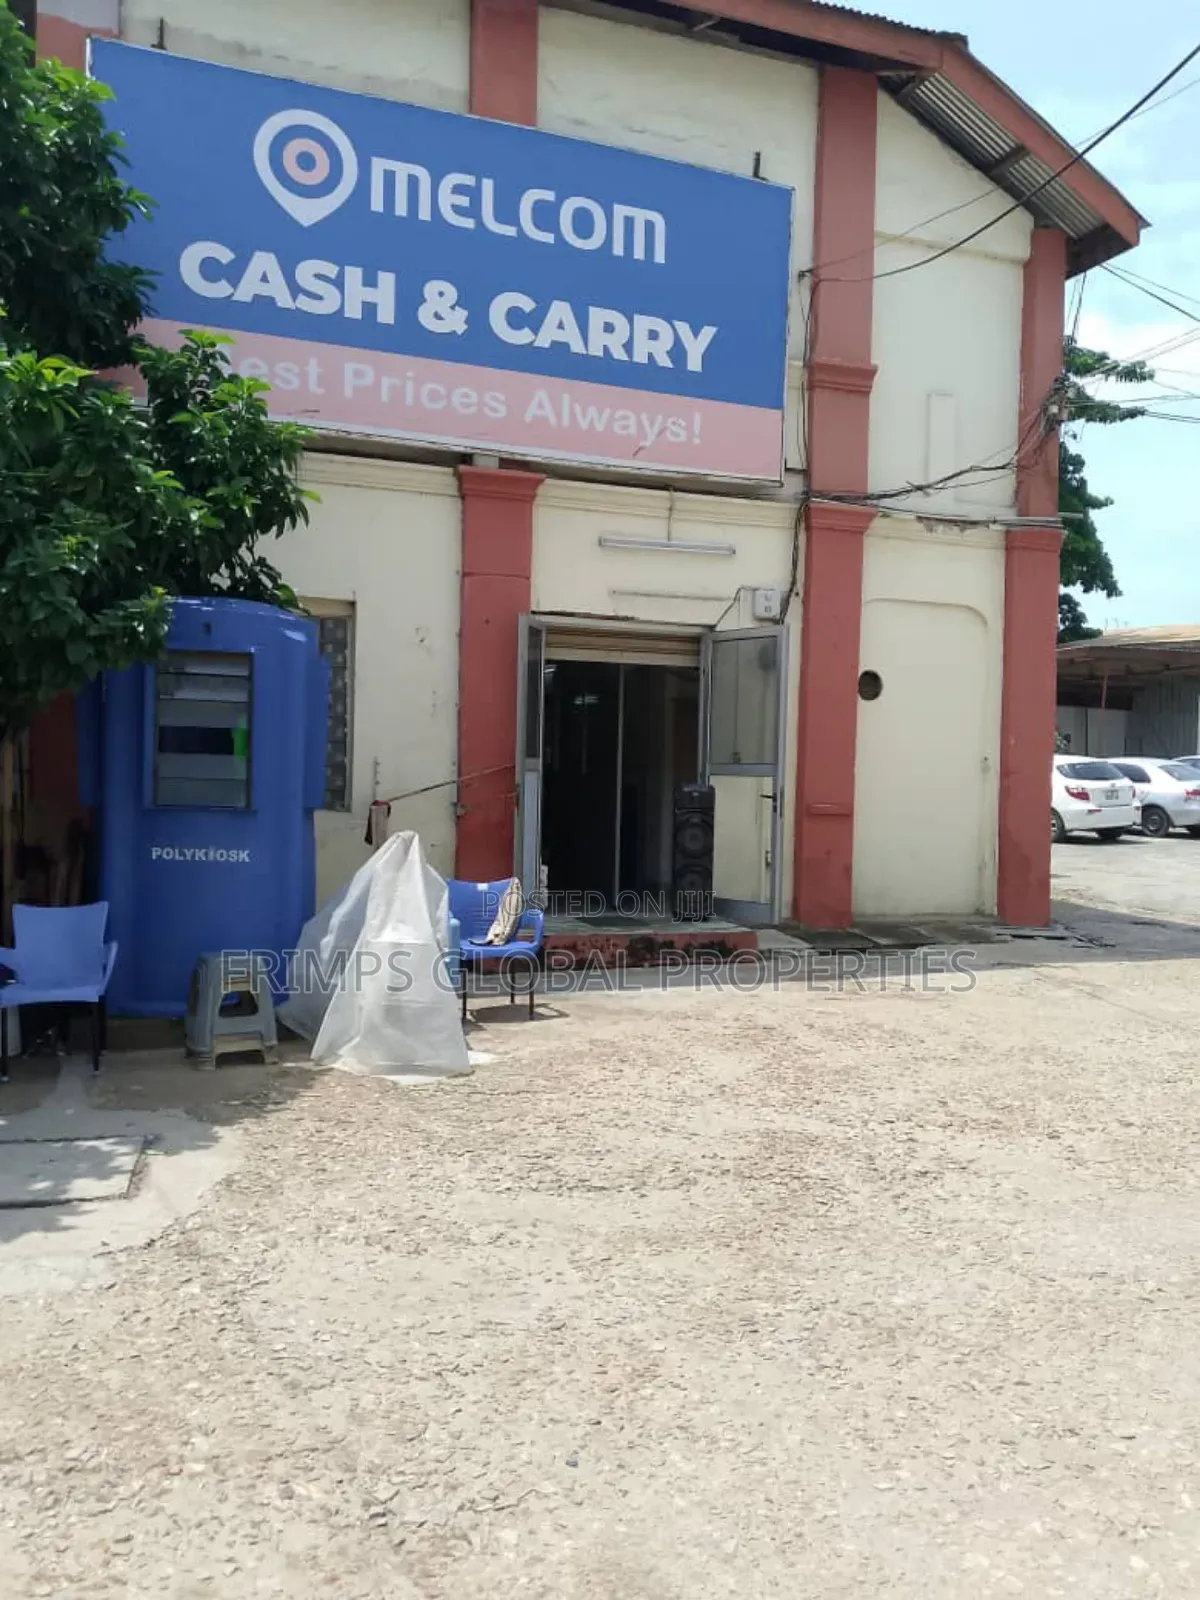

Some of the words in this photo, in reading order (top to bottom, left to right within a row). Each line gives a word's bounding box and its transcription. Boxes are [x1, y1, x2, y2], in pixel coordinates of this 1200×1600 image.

[370, 156, 667, 265] MELCOM
[179, 241, 396, 326] CASH
[417, 280, 469, 335] &
[488, 292, 718, 373] CARRY
[214, 345, 325, 395] est
[343, 362, 508, 420] Prices
[523, 388, 703, 447] Always!
